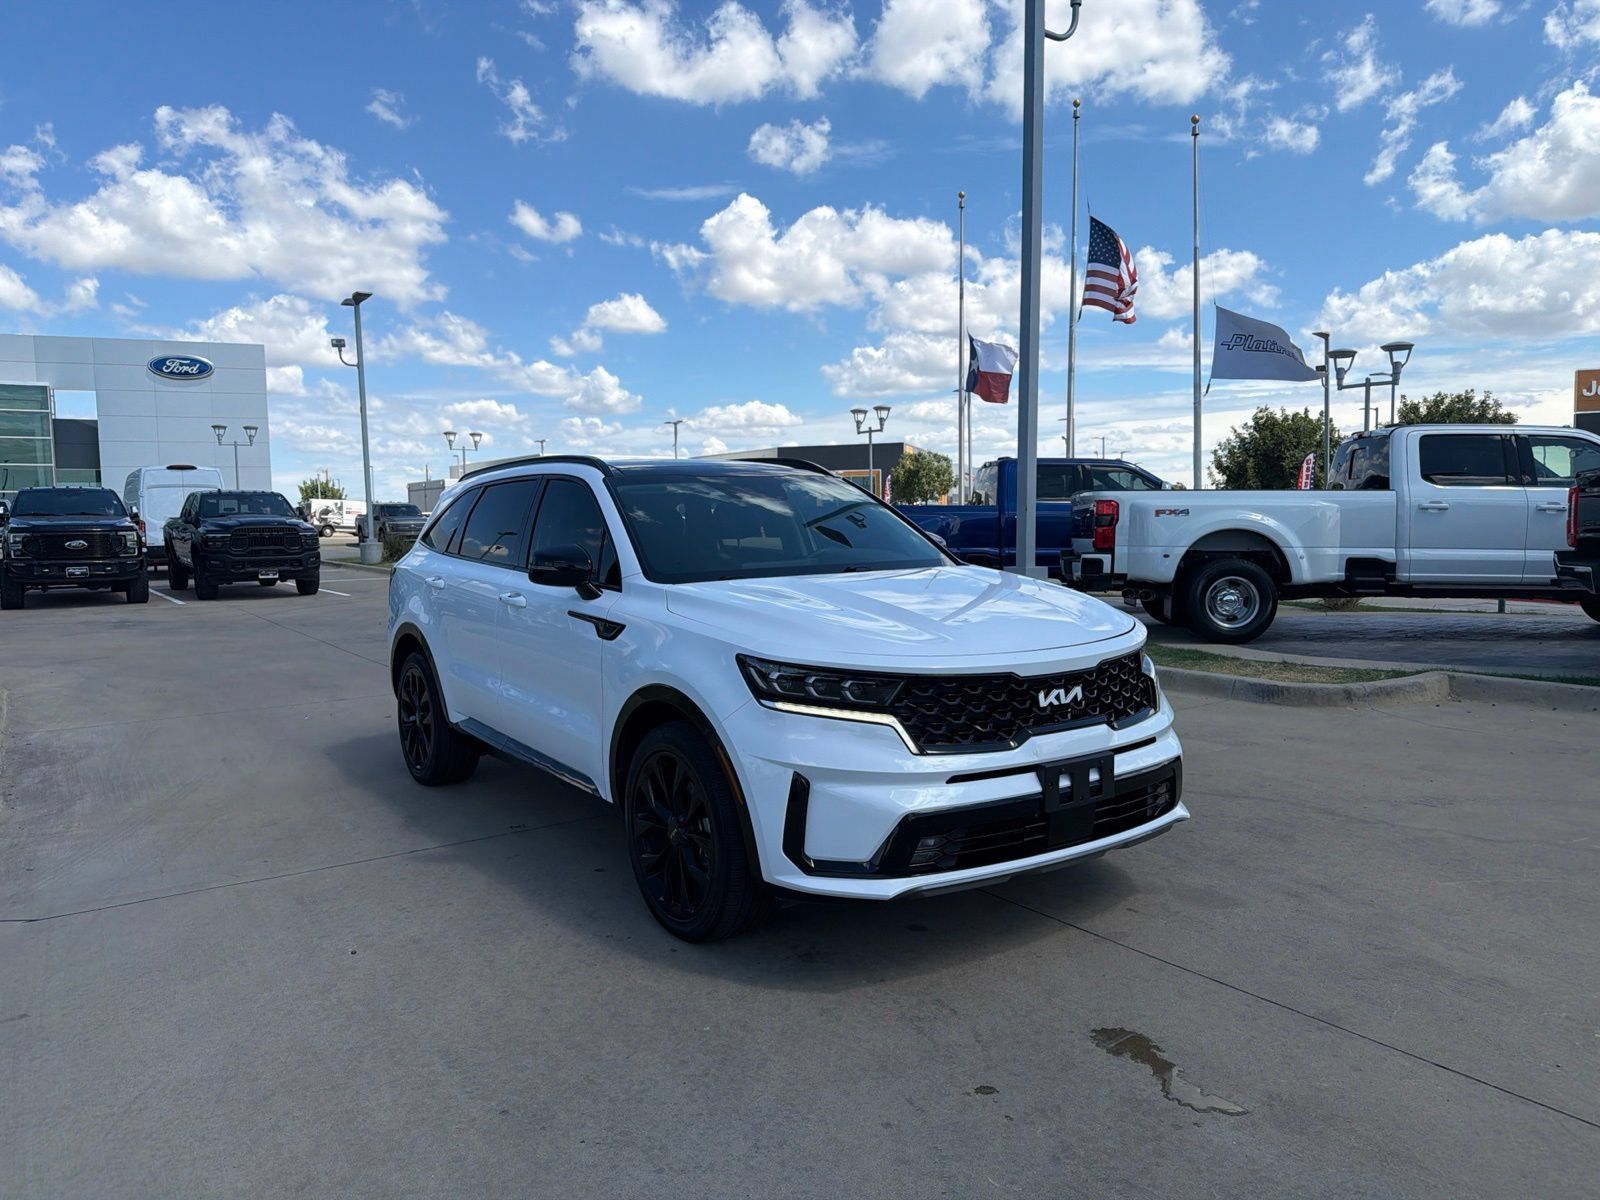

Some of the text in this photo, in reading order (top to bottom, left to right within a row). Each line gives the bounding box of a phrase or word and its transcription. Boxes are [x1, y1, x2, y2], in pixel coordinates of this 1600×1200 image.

[162, 359, 200, 374] Ford
[1582, 380, 1600, 396] J
[1154, 508, 1190, 517] FX4
[1038, 684, 1083, 708] KIA
